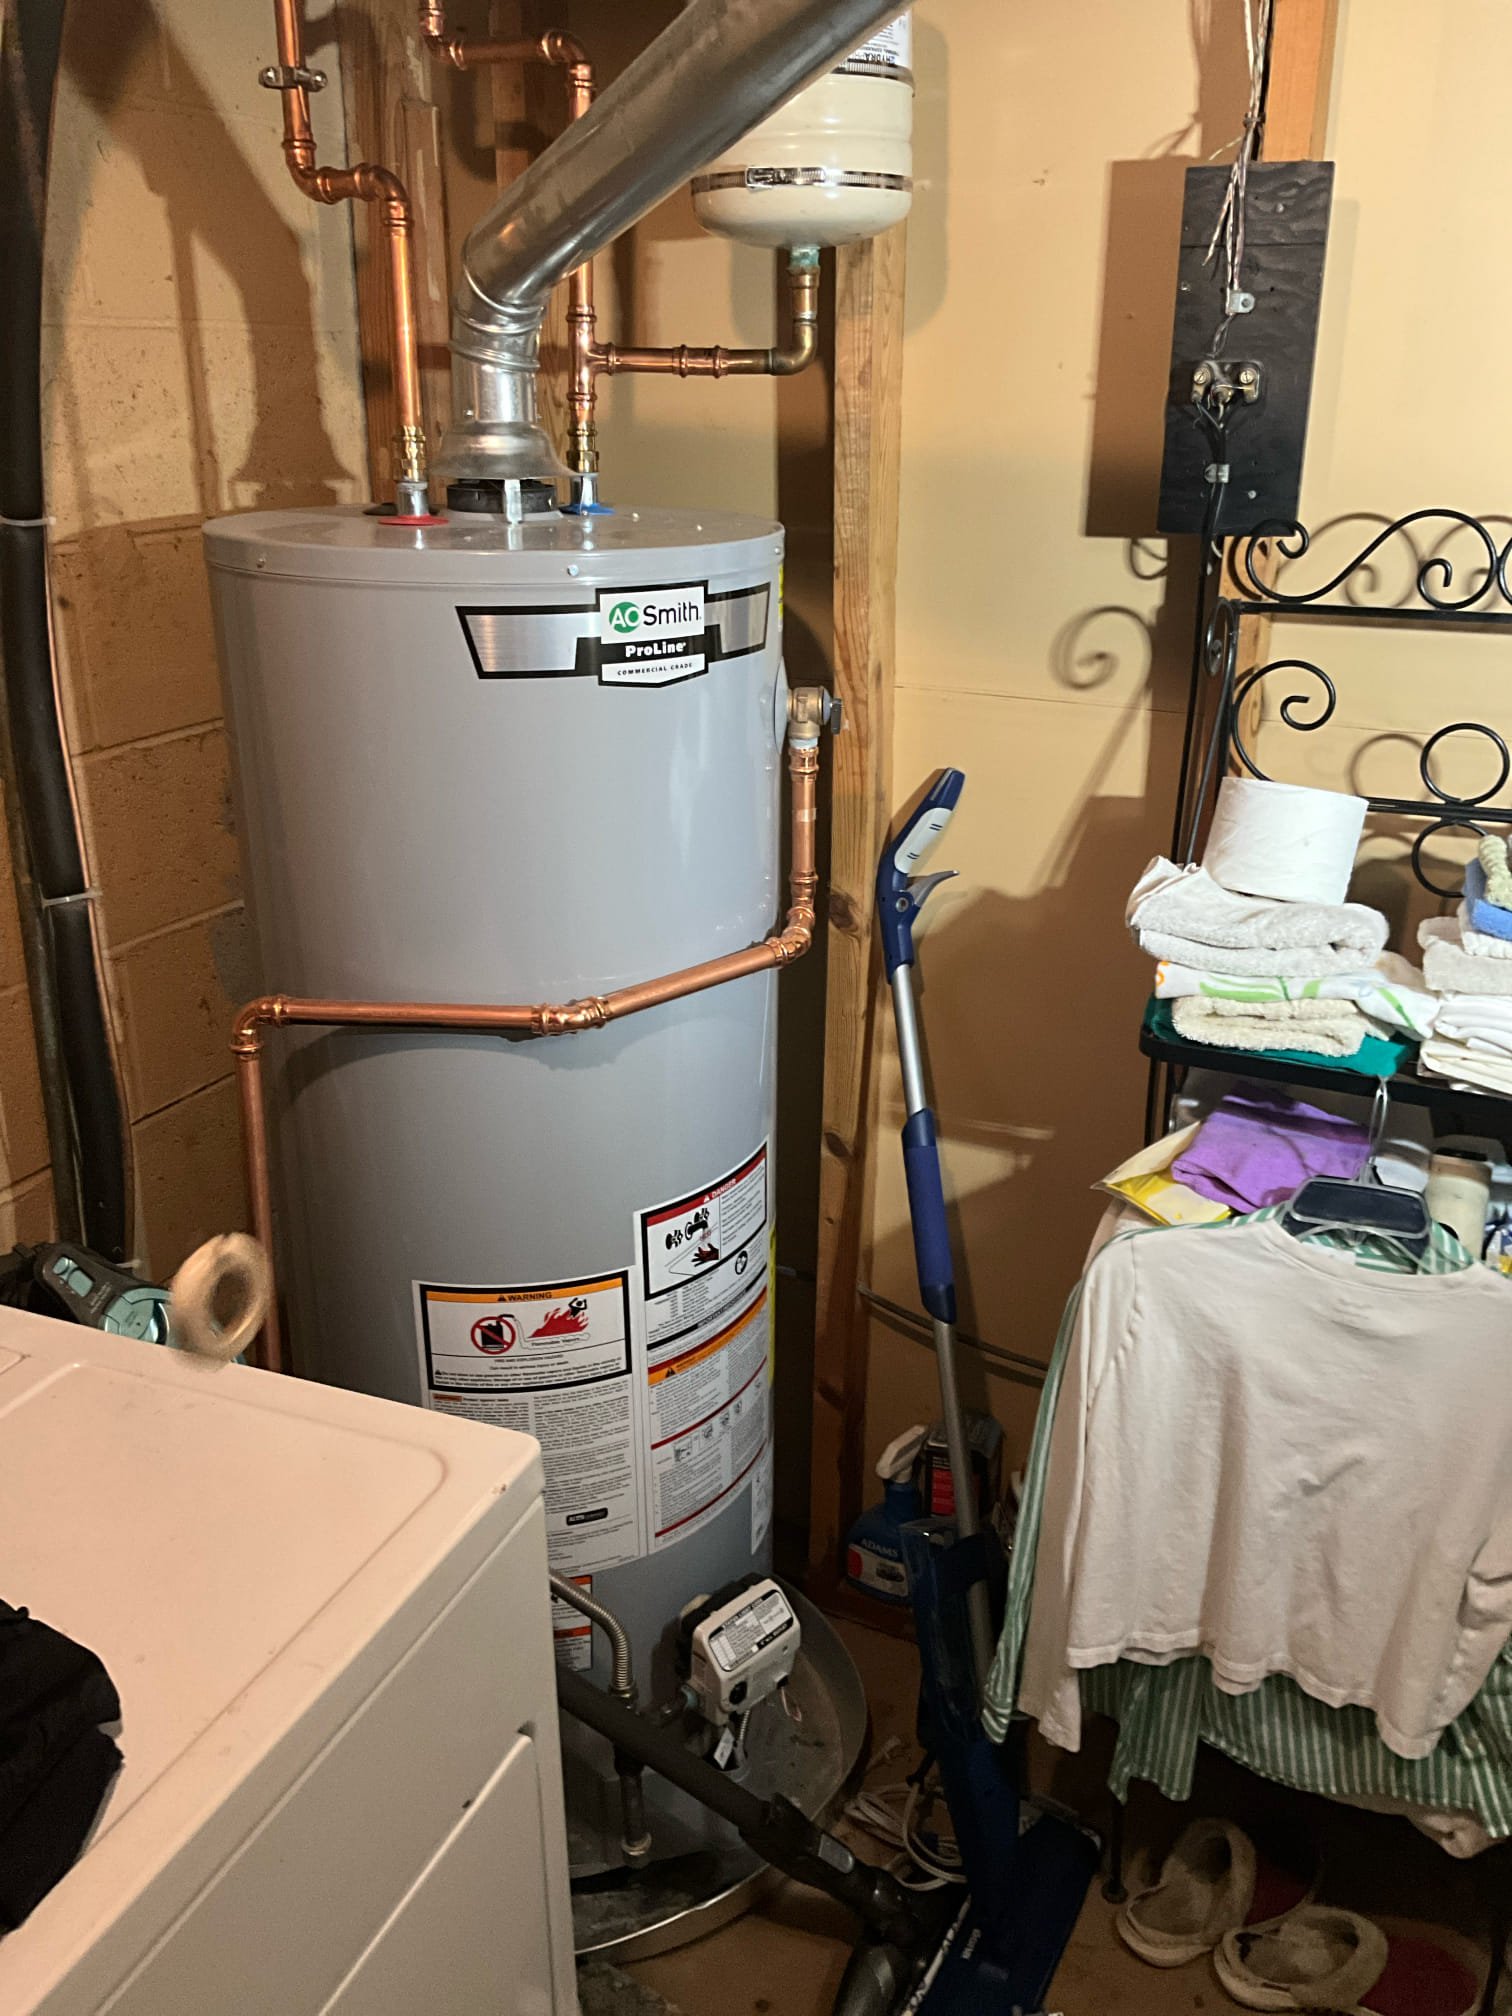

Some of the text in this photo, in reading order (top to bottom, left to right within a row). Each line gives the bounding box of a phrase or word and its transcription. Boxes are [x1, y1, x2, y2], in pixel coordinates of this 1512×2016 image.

[643, 602, 699, 626] Smith
[625, 641, 685, 658] ProLine
[617, 662, 693, 676] COMMERCIAL GRADE
[711, 1178, 737, 1198] DANGER
[508, 1291, 553, 1302] WARNING
[861, 1538, 898, 1557] ADAMS
